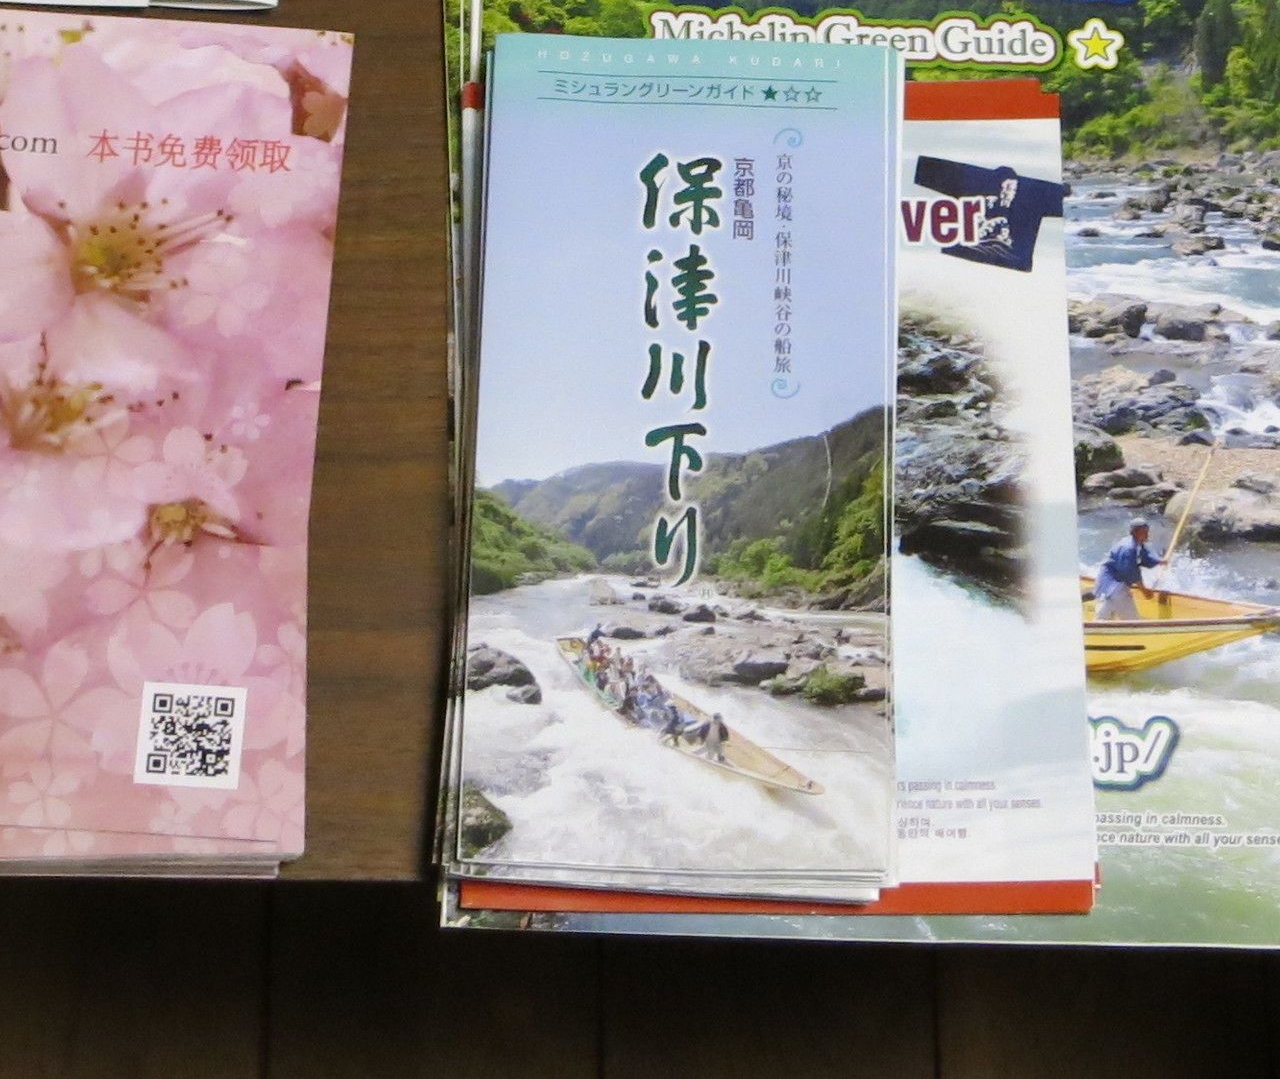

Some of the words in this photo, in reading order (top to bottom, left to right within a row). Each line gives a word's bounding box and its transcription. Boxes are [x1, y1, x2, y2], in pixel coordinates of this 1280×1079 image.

[657, 19, 808, 42] Michelin
[823, 21, 928, 53] Green
[941, 25, 1047, 56] Guide
[537, 49, 702, 65] HOZUGAWA
[729, 57, 841, 69] KUDARI
[554, 79, 754, 100] ミシュラングリーンガイド
[87, 130, 292, 174] 本书免费领取
[733, 158, 755, 241] 京都亀岡
[639, 152, 723, 589] 保津川下り
[1146, 813, 1157, 825] in
[1162, 813, 1223, 826] calmness.
[1121, 833, 1160, 844] nature
[1165, 832, 1190, 844] with
[1195, 833, 1209, 844] all
[1213, 834, 1242, 848] your
